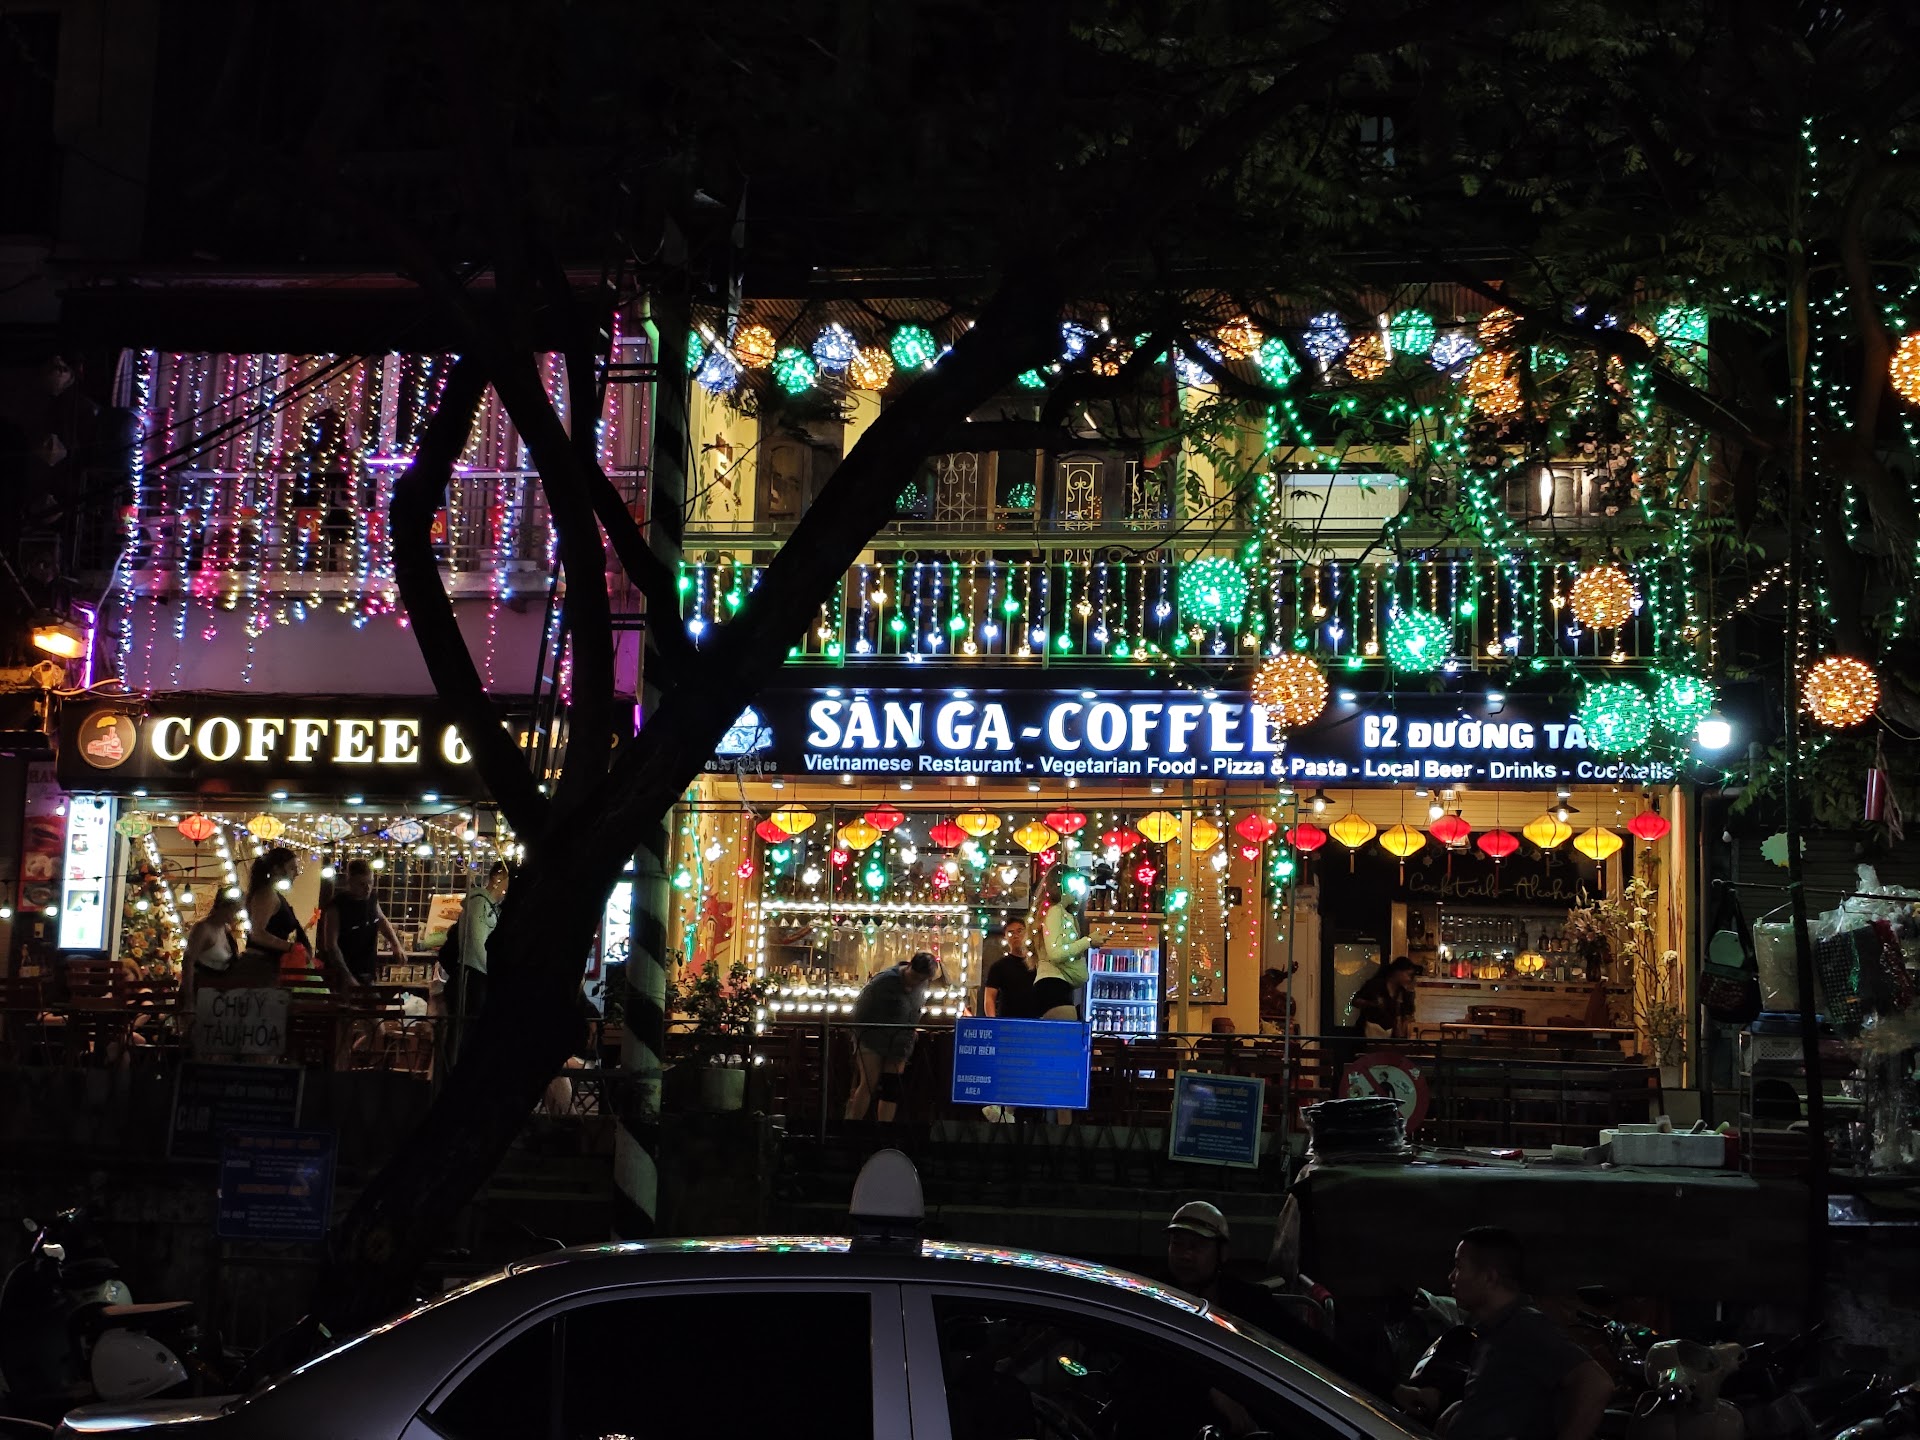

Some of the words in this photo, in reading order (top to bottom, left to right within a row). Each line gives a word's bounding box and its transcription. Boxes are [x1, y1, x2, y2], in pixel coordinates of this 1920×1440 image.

[151, 716, 419, 763] COFFEE
[936, 701, 1014, 751] GA
[1048, 702, 1286, 753] COFFEE
[1362, 714, 1398, 748] 62
[804, 754, 913, 772] Vietnamese
[919, 755, 1023, 773] Restaurant
[1040, 756, 1141, 777] Vegetarian
[1146, 757, 1197, 775] Food
[1213, 758, 1265, 776] Pizza
[1270, 758, 1286, 776] &
[1291, 758, 1347, 777] Pasta
[1363, 759, 1419, 777] Local
[1422, 760, 1473, 778] Beer
[1489, 761, 1556, 779] Drinks
[957, 1074, 992, 1084] DANGEROUS
